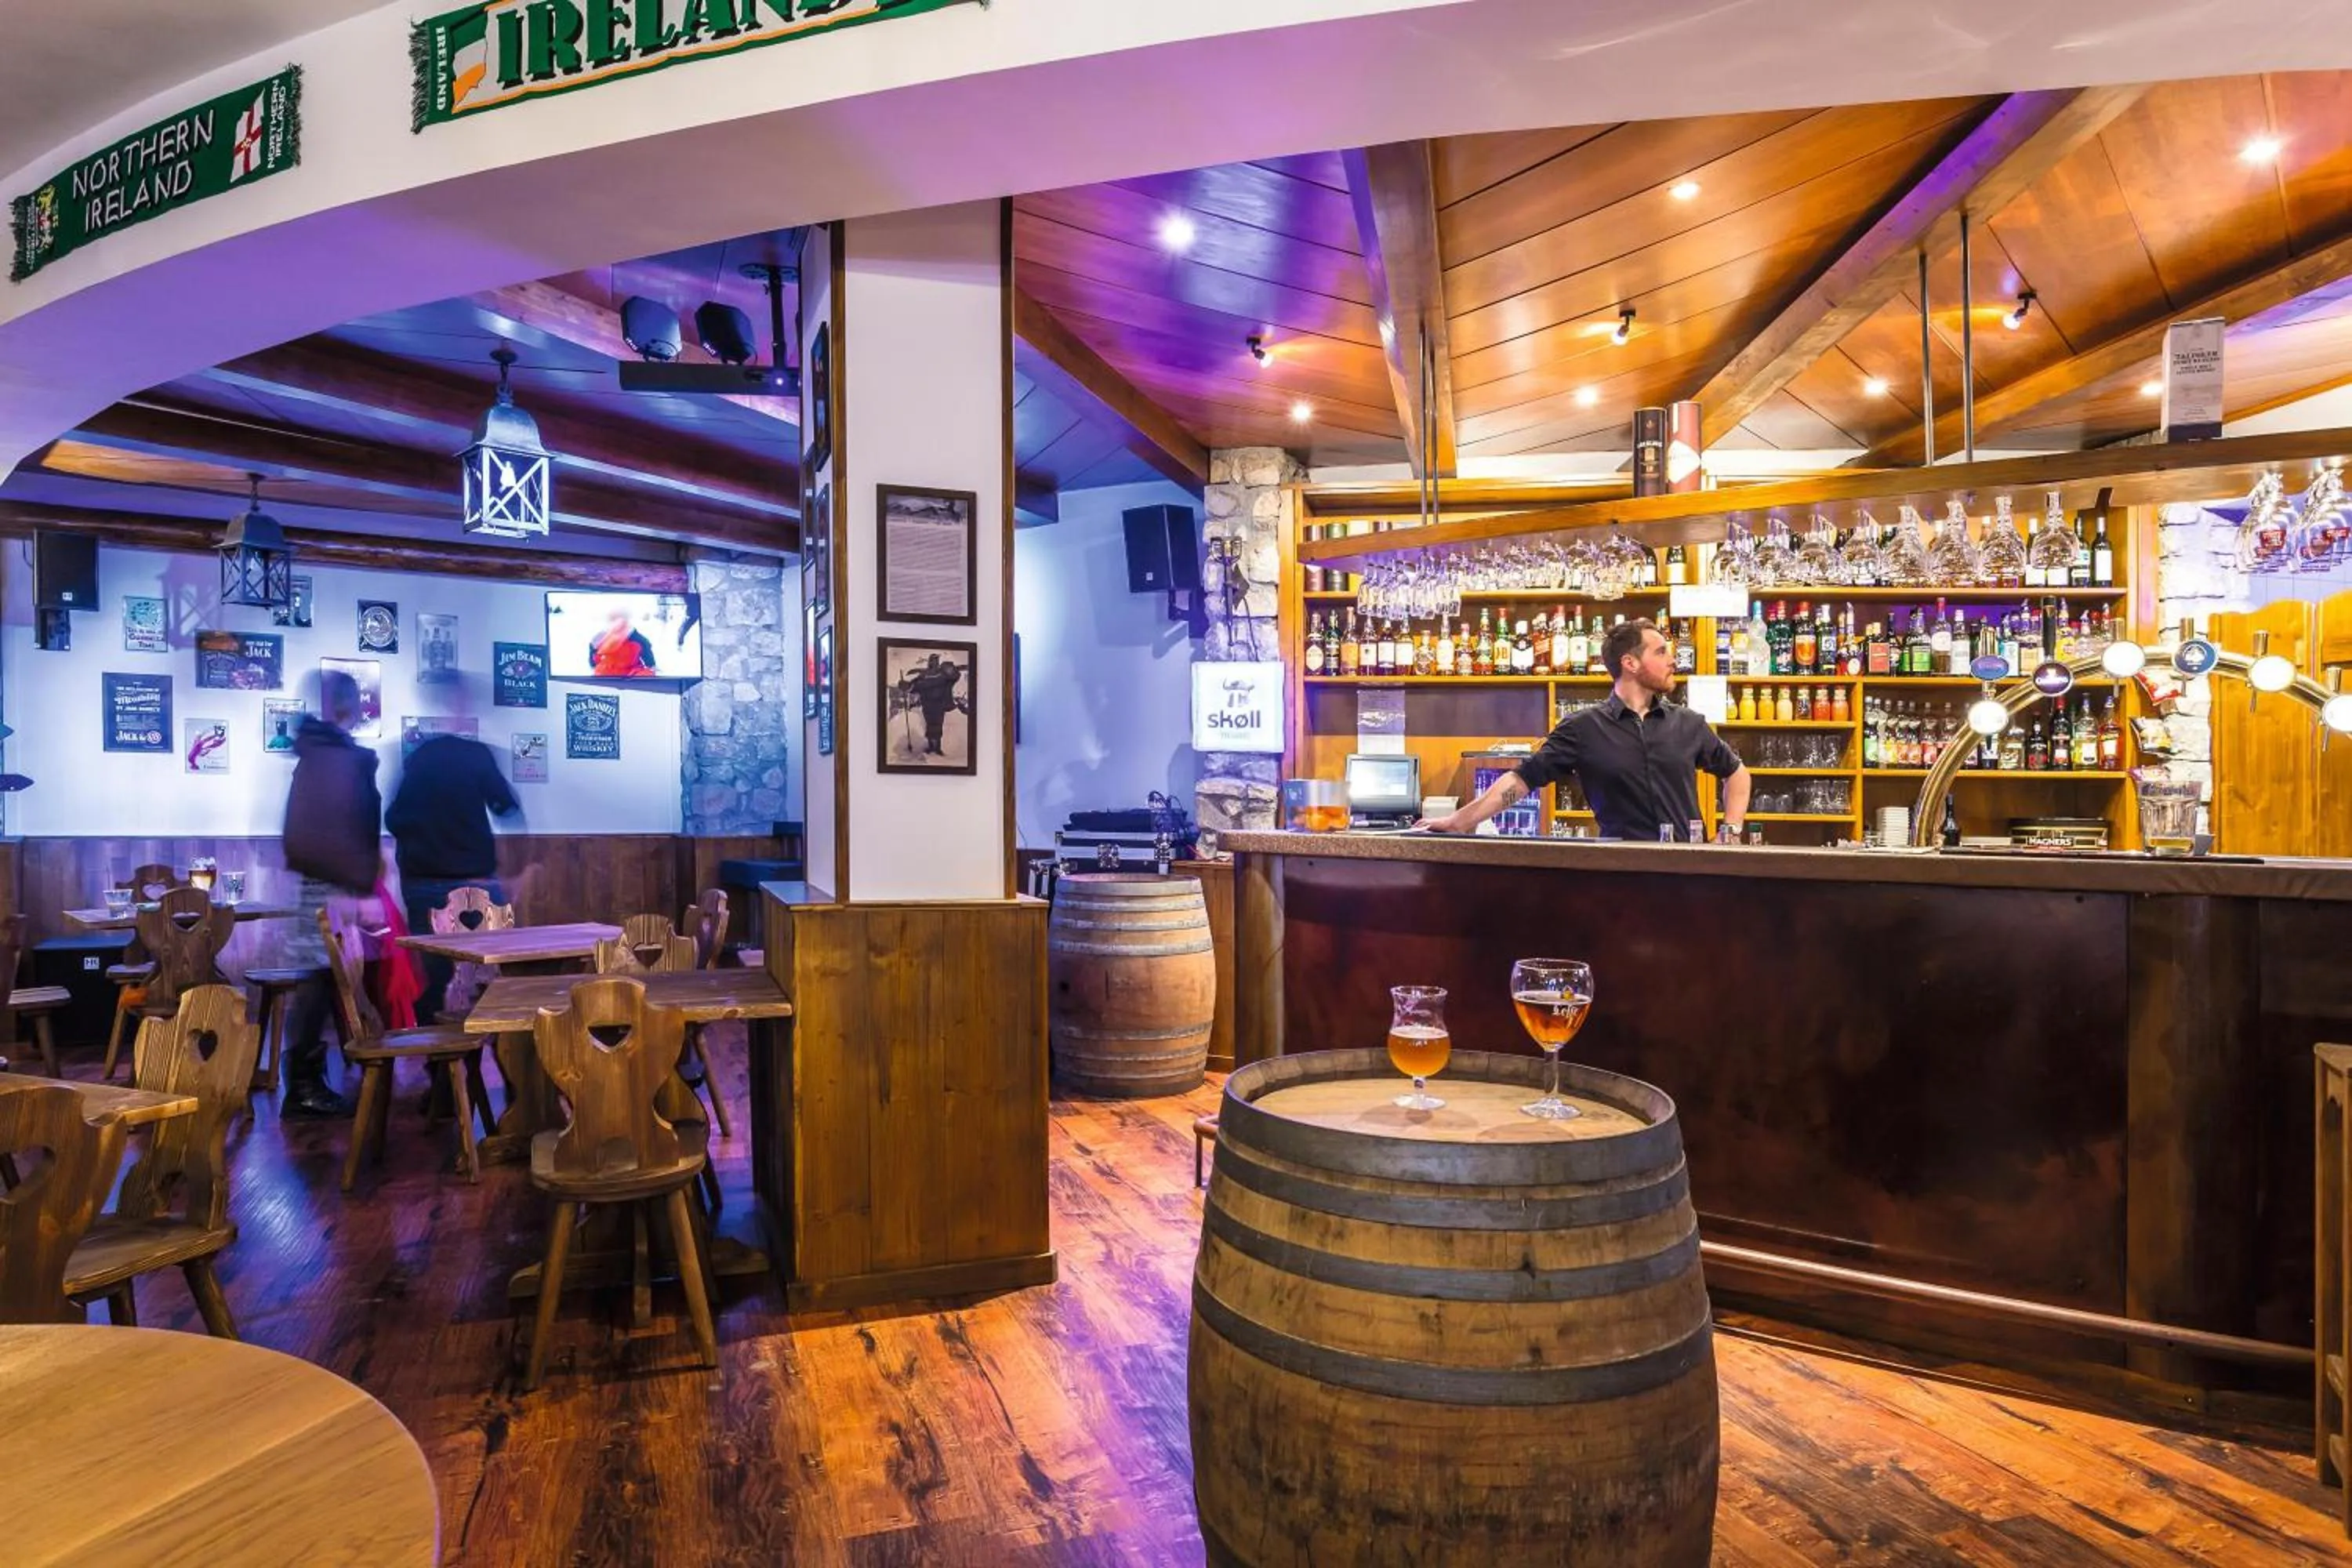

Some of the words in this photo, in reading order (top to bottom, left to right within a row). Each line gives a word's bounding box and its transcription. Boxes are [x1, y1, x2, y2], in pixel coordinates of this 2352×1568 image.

[435, 26, 447, 111] IRELAND
[496, 0, 855, 88] IRELA
[73, 109, 214, 199] NORTHERN
[267, 79, 280, 169] NORTHERN
[275, 85, 286, 157] IRELAND
[85, 160, 192, 232] IRELAND
[498, 652, 516, 666] JIM
[504, 679, 536, 688] BLACK
[1207, 710, 1261, 728] skøll
